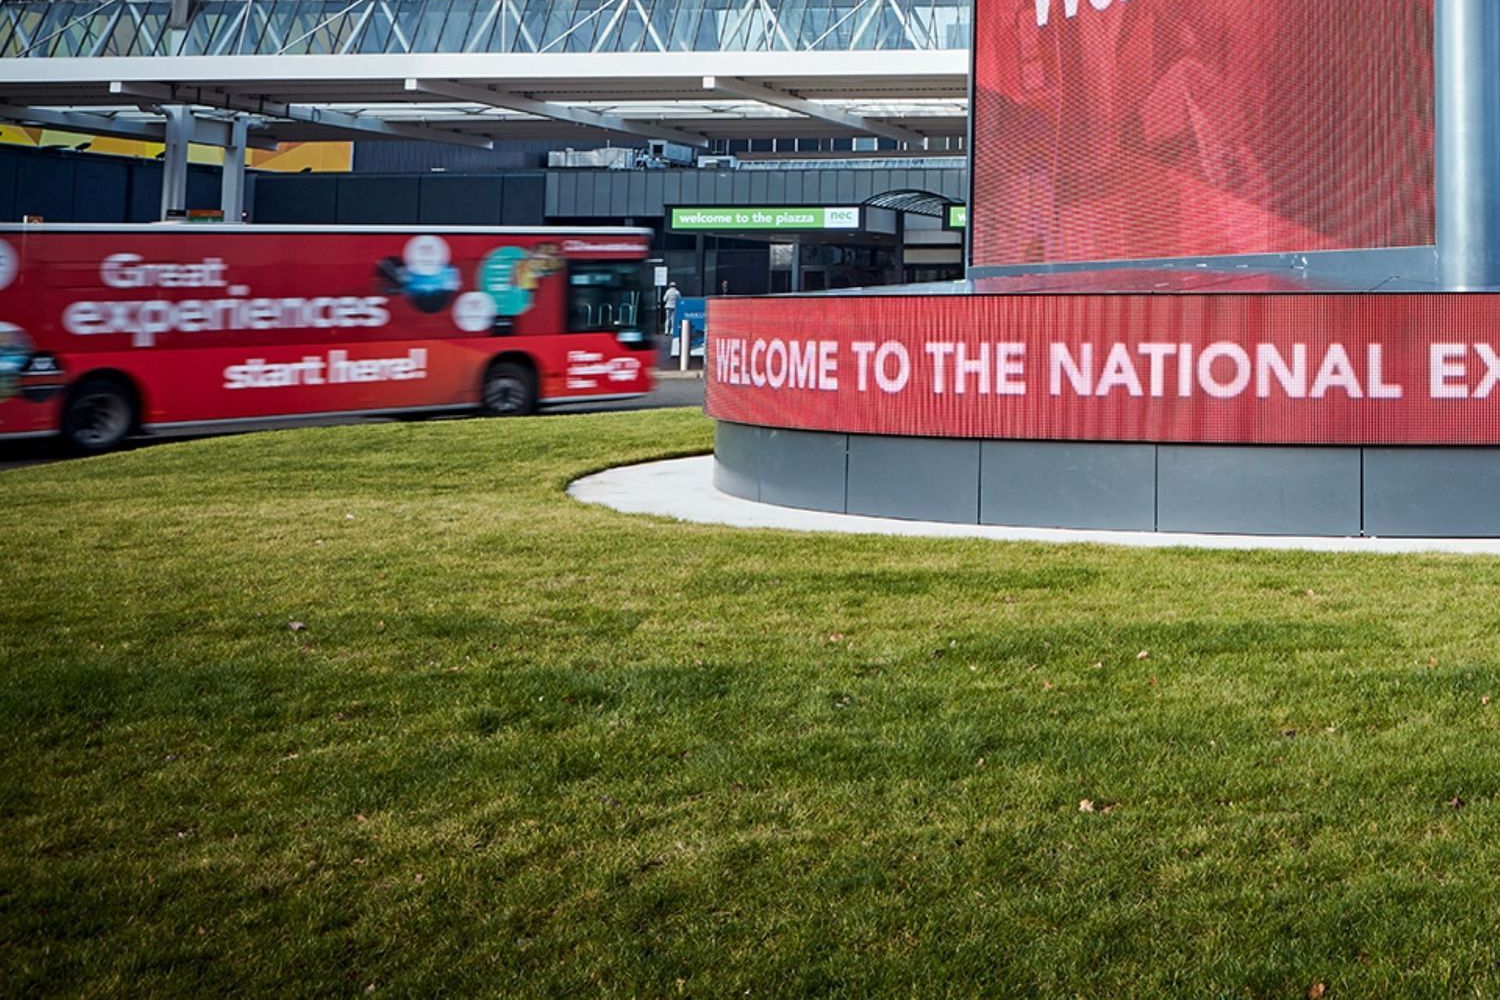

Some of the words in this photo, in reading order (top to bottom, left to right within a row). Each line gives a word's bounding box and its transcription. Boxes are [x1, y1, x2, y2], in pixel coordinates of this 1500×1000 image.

[678, 211, 732, 224] welcome
[735, 212, 749, 224] to
[752, 211, 772, 224] the
[775, 212, 814, 226] piazza
[830, 210, 853, 221] nec
[100, 253, 228, 288] Great
[63, 285, 390, 347] experiences
[222, 358, 325, 389] start
[327, 348, 427, 384] here!
[715, 337, 838, 391] WELCOME
[851, 340, 911, 393] TO
[925, 341, 1026, 395] THE
[1049, 341, 1402, 398] NATIONAL
